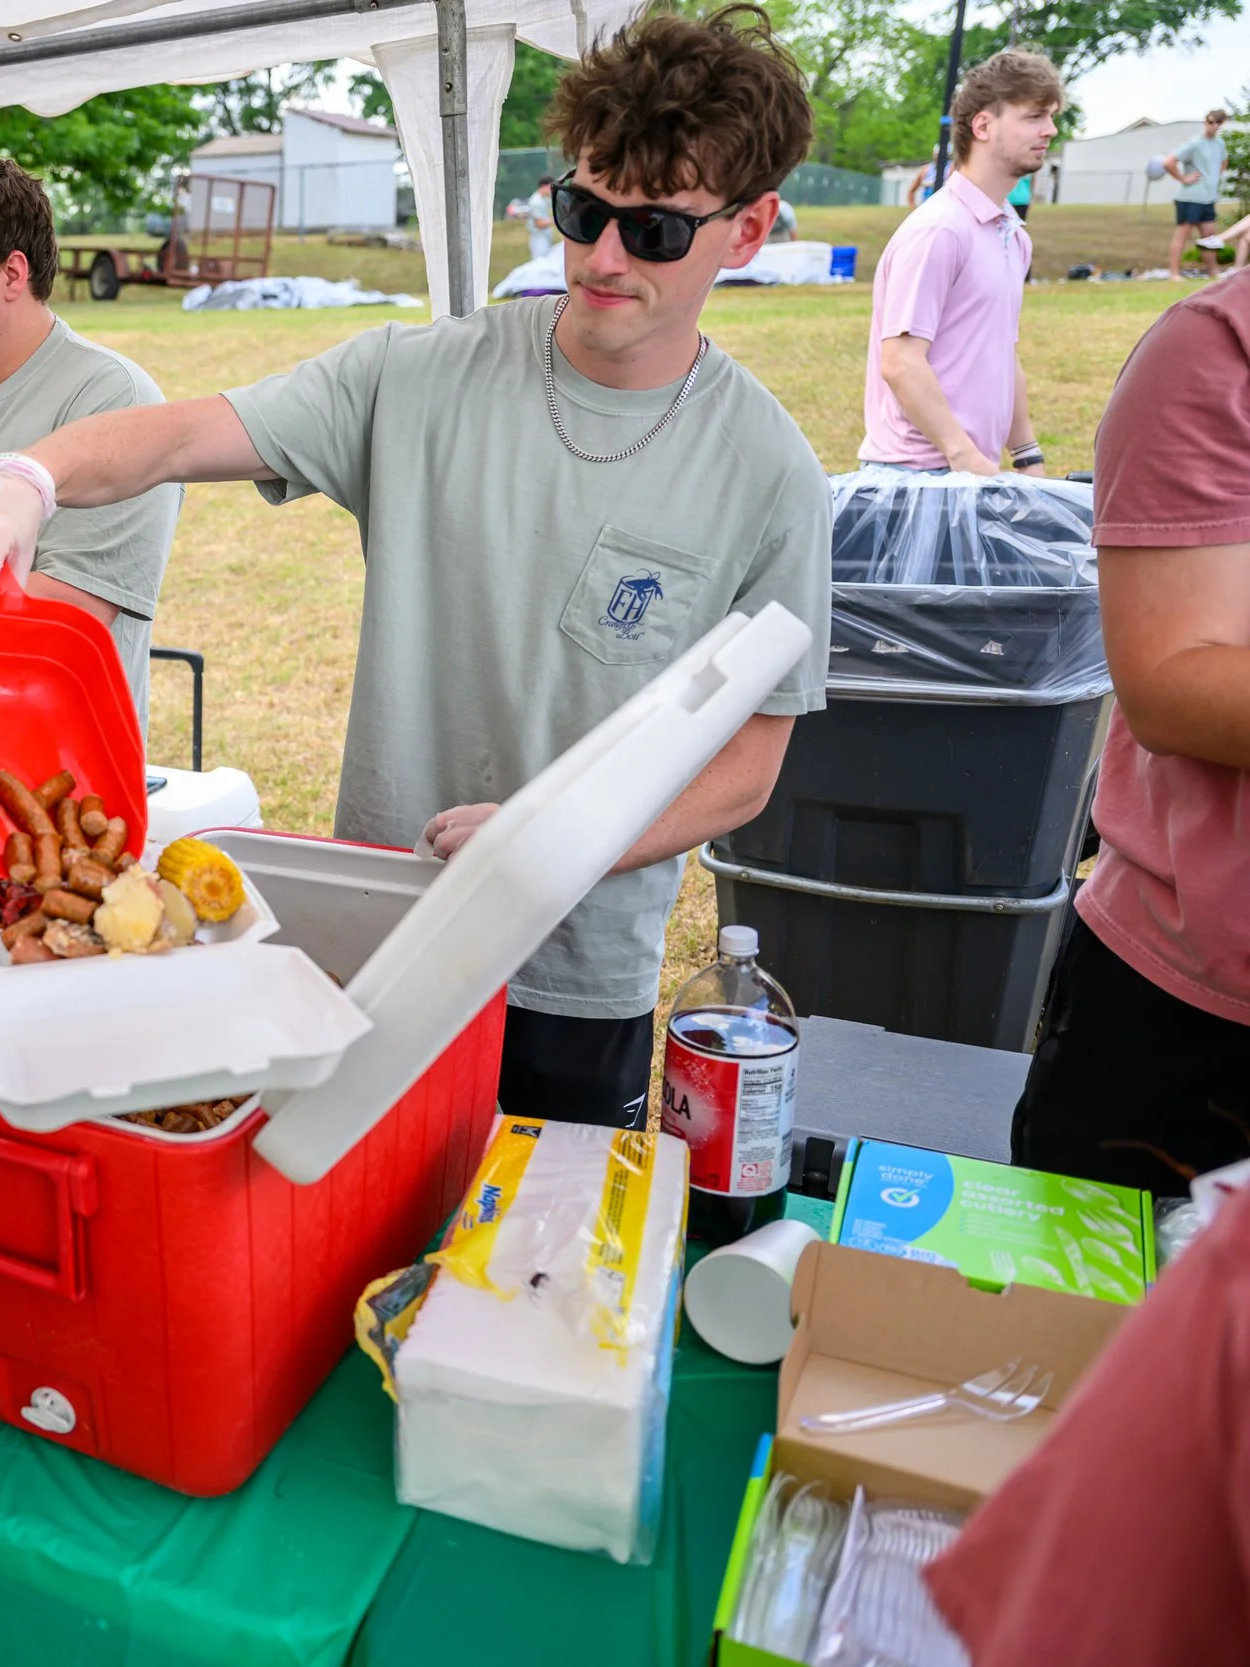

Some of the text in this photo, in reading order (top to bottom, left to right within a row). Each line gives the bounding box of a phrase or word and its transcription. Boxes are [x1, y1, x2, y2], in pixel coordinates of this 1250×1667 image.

[877, 1164, 934, 1180] simply
[962, 1179, 1020, 1198] clear
[959, 1199, 1041, 1222] cutlery
[961, 1190, 1065, 1216] assorted
